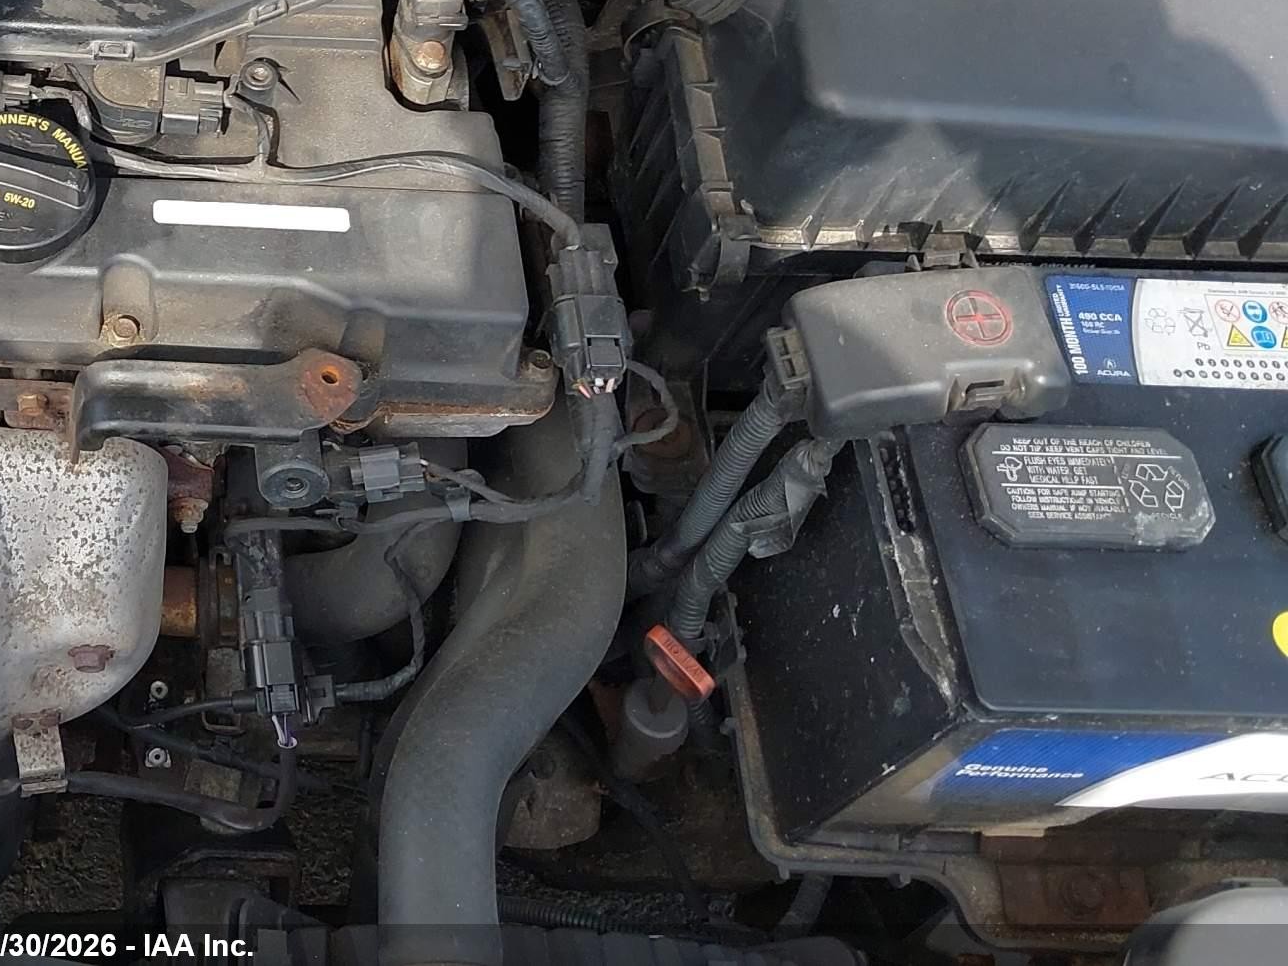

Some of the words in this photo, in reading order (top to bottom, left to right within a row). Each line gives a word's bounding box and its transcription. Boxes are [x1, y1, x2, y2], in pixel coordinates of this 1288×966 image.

[52, 127, 89, 171] MANUA
[3, 192, 36, 210] 5W-20
[1099, 312, 1123, 322] CCA
[1059, 316, 1083, 355] MONTH
[1196, 341, 1211, 351] Pb
[1070, 356, 1089, 375] 100
[1096, 369, 1131, 377] ACURA
[1013, 437, 1031, 445] KEEP
[1033, 437, 1048, 445] OUT
[1062, 438, 1078, 446] THE
[1116, 440, 1152, 448] CHILDREN
[1013, 444, 1028, 452] NOT
[1045, 445, 1063, 453] KEEP
[1023, 456, 1047, 465] FLUSH
[1048, 456, 1066, 465] EYES
[1067, 457, 1112, 466] IMMEDIATELY
[1026, 465, 1044, 474] WITH
[1073, 466, 1088, 475] GET
[1029, 475, 1061, 483] MEDICAL
[1061, 476, 1080, 484] HELP
[1080, 476, 1098, 485] FAST
[1038, 488, 1051, 496] FOR
[1071, 489, 1087, 497] JUMP
[1011, 495, 1037, 503] FOLLOW
[1039, 496, 1085, 504] INSTRUCTIONS
[1045, 512, 1073, 520] SERVICE
[964, 763, 1048, 774] Genuine
[955, 769, 1084, 780] Performance
[1198, 772, 1288, 782] AC
